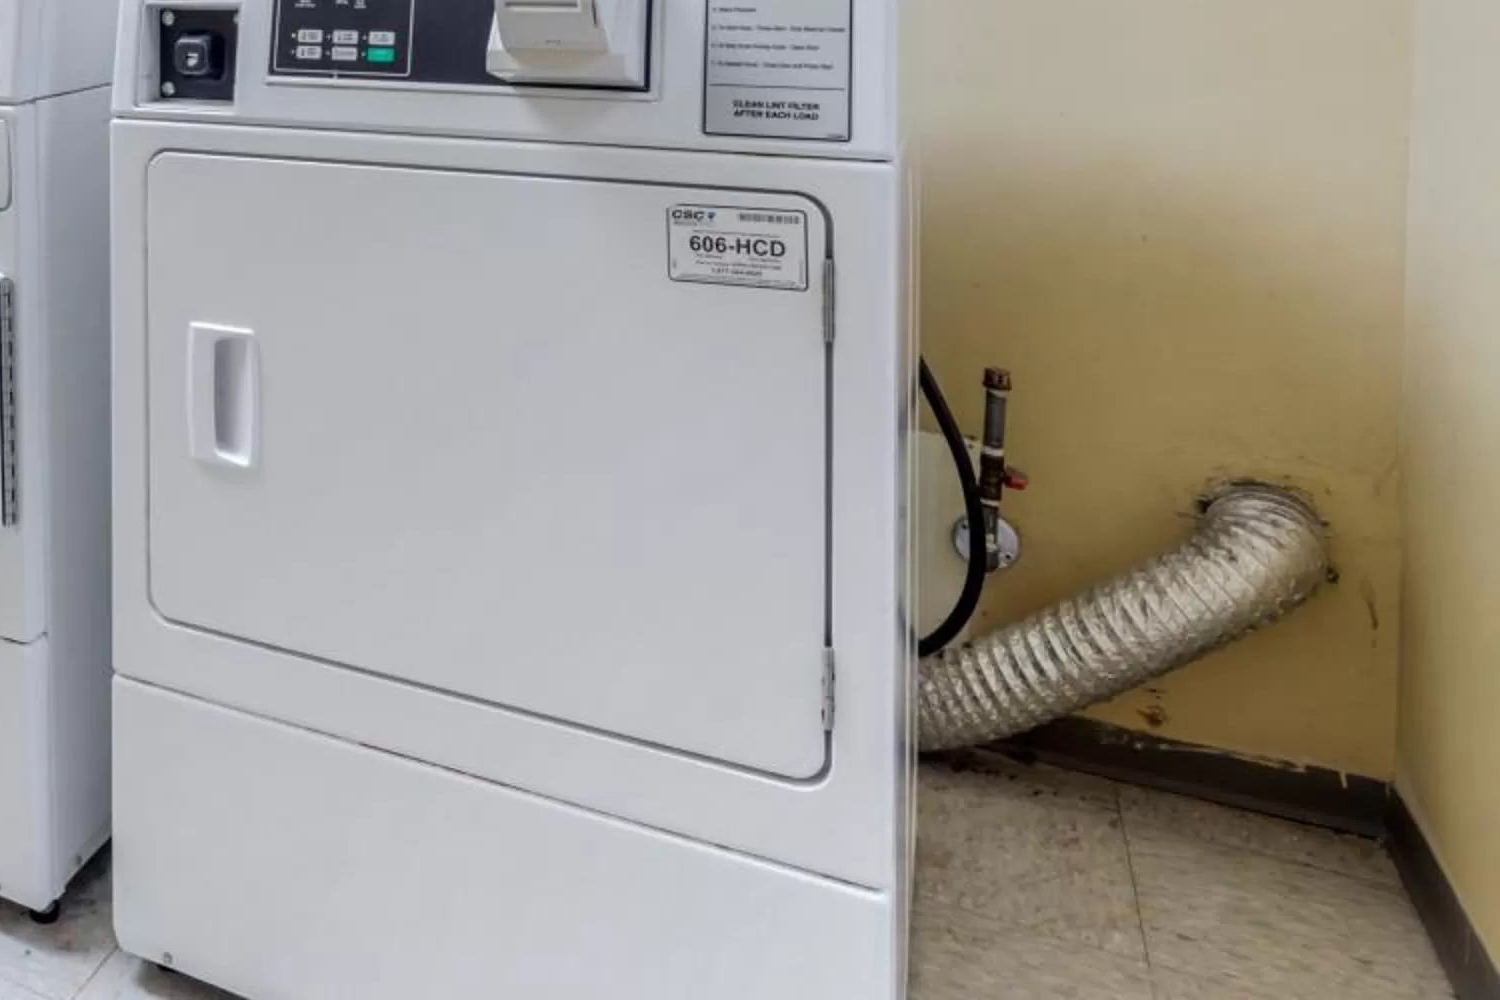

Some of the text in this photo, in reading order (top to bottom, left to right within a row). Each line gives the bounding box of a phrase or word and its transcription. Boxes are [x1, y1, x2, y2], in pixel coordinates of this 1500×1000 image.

[732, 99, 764, 109] CLEAN
[733, 109, 820, 121] AFTER EACH LOAD
[689, 235, 786, 257] 606-HCD
